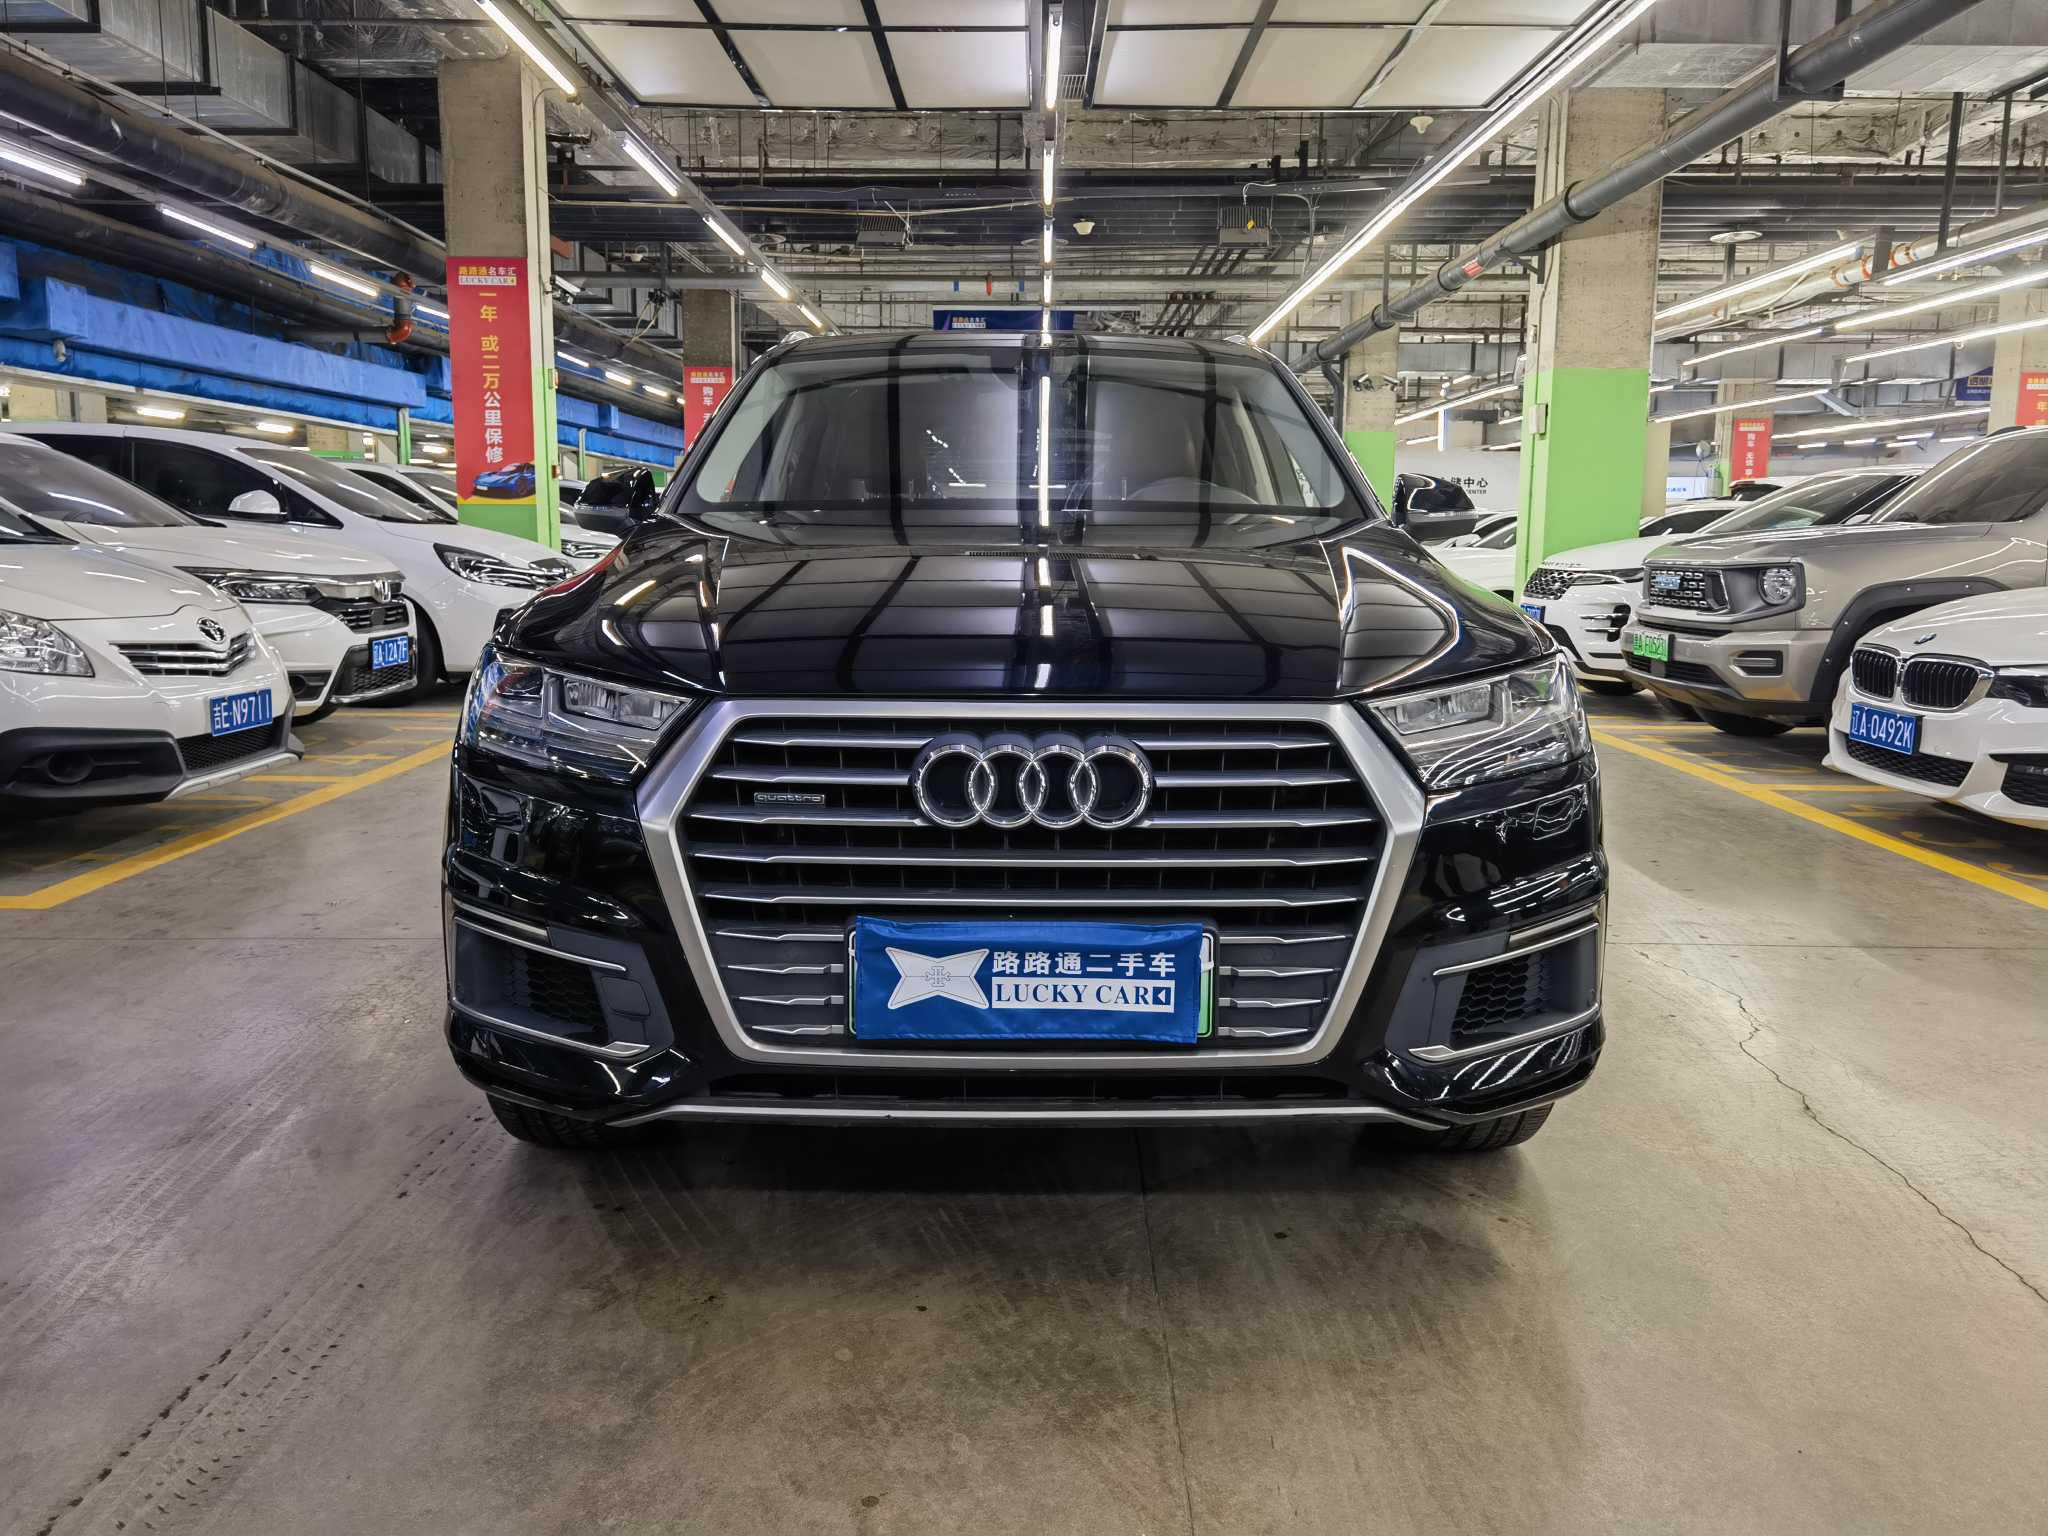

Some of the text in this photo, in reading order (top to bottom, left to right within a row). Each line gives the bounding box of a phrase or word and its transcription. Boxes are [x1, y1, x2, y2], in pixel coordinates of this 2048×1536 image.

[756, 793, 822, 803] quattro
[991, 950, 1176, 978] 路路通二手车
[994, 983, 1150, 1006] LUCKY CAR
